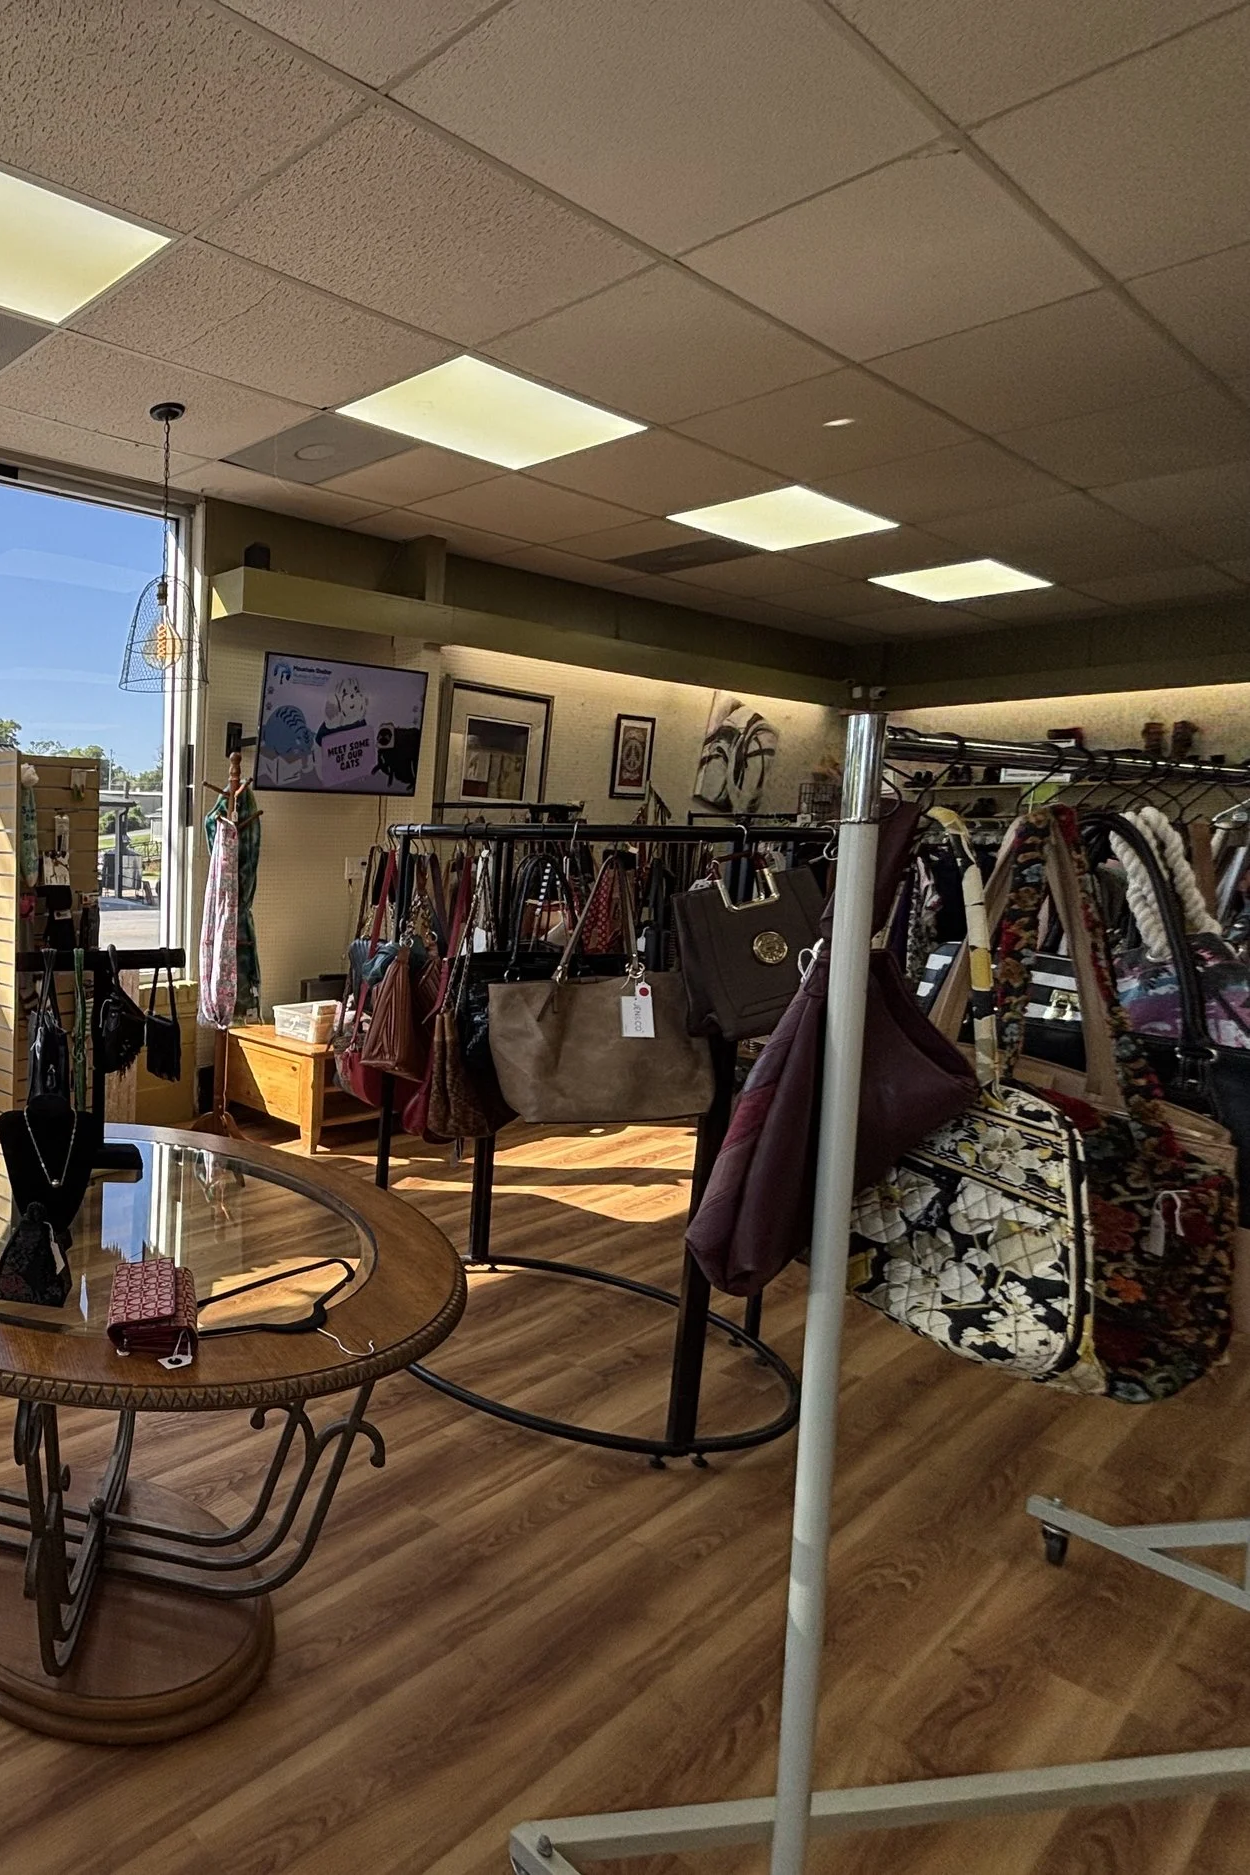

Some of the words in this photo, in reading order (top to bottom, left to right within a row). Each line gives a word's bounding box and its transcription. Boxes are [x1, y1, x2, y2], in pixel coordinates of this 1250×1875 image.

[327, 744, 347, 757] MEET
[349, 738, 370, 751] SOME
[336, 753, 345, 763] OF
[347, 749, 363, 760] OUR
[340, 758, 360, 771] CATS
